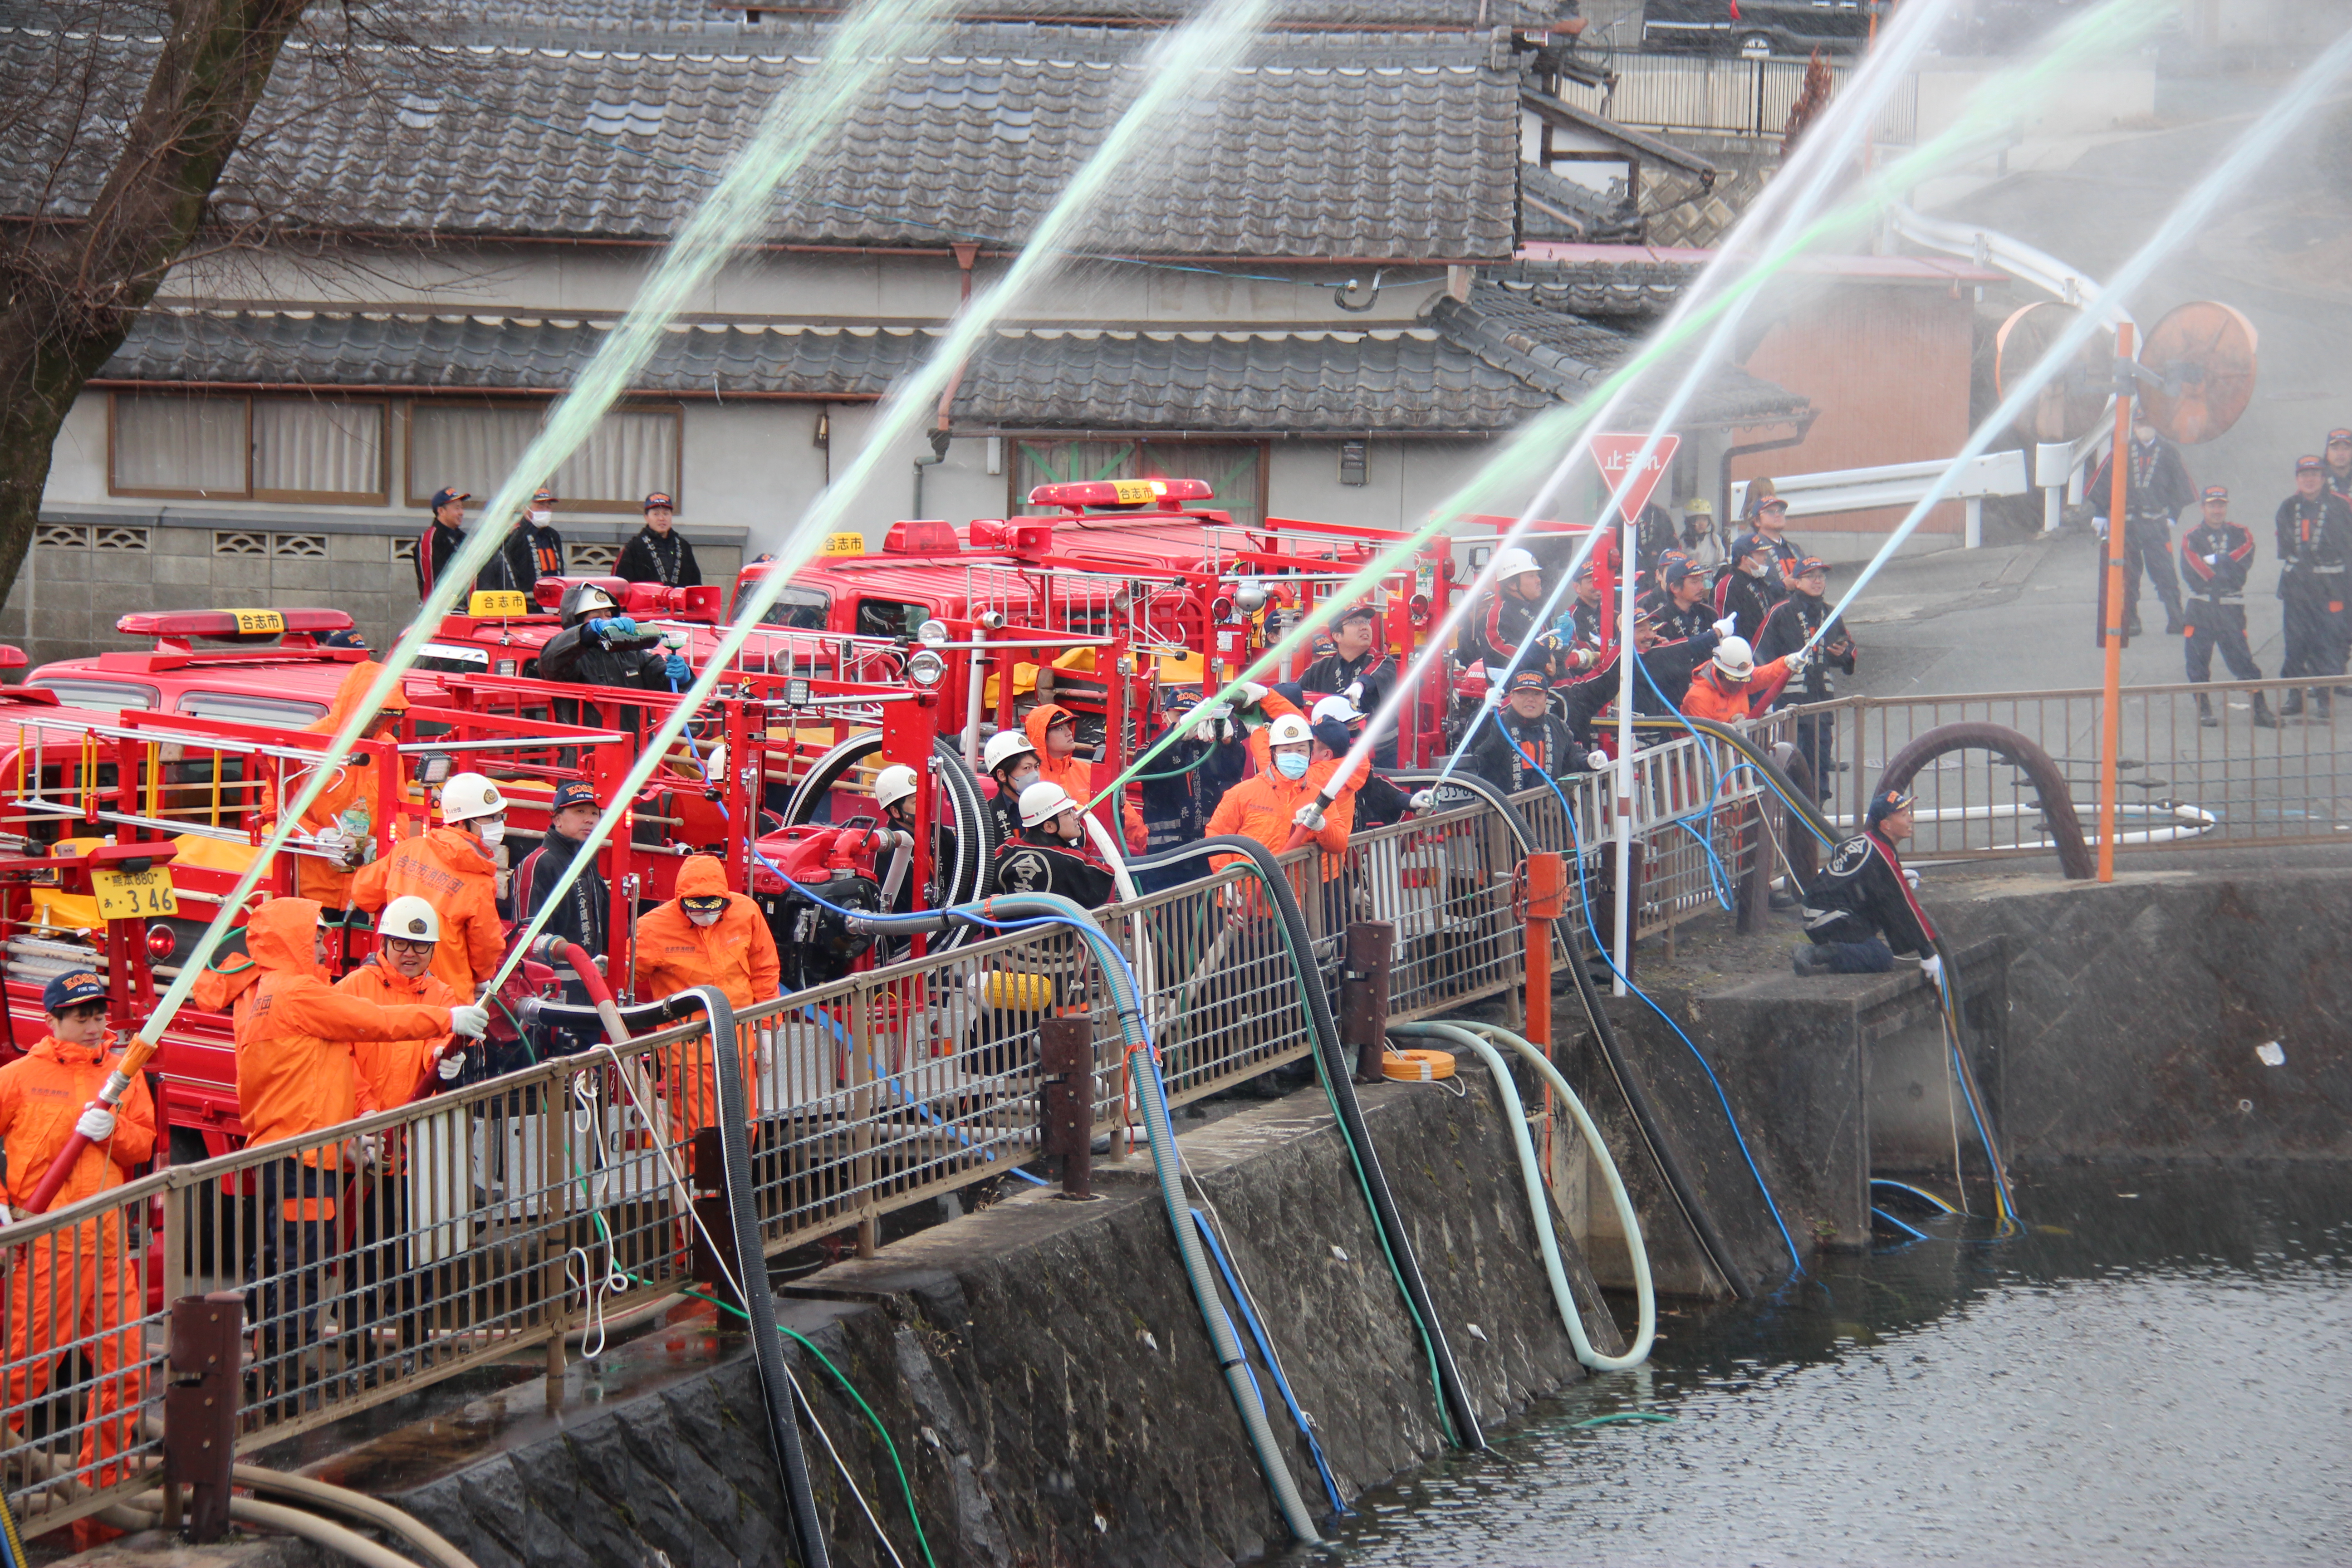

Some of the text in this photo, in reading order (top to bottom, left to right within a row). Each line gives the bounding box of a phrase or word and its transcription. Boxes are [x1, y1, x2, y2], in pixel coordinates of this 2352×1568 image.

[1119, 486, 1153, 500] 合志市
[825, 537, 862, 551] 合志市
[484, 595, 523, 608] 合志市
[241, 614, 280, 630] 合志市
[1516, 673, 1543, 684] KOSHI
[1035, 805, 1053, 817] 第13分団
[396, 855, 465, 893] 合志市消防団
